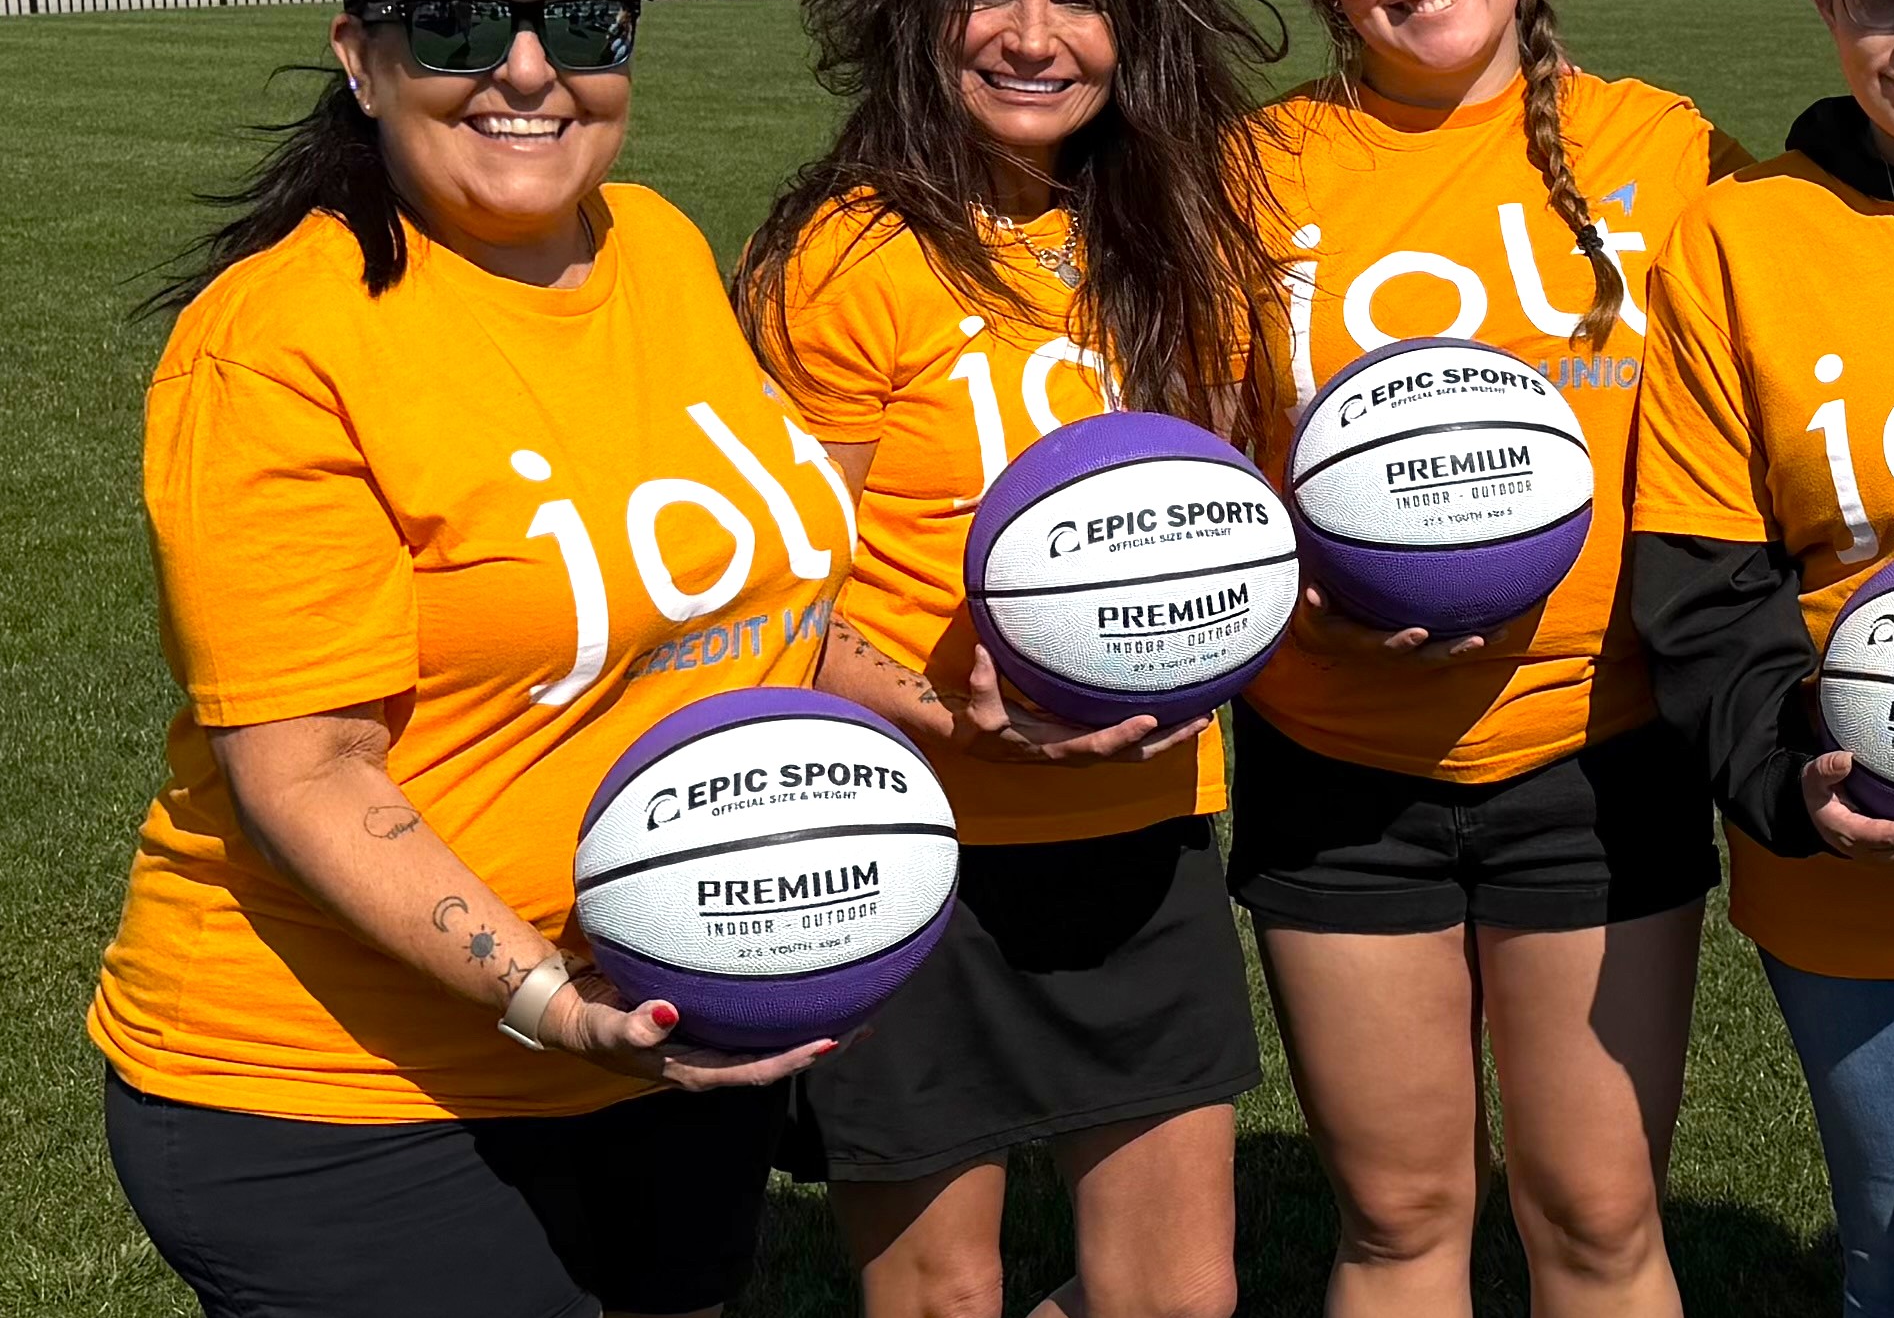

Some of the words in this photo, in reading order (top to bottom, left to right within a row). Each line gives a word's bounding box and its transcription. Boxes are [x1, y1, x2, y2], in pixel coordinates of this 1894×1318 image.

[1283, 202, 1648, 423] jolt
[1371, 372, 1434, 406] EPIC
[1443, 368, 1546, 395] SPORTS
[1539, 355, 1641, 390] UNIO
[1386, 446, 1530, 484] PREMIUM
[1396, 491, 1450, 509] INDOOR
[1472, 480, 1532, 499] OUTDOOR
[1087, 509, 1157, 544] EPIC
[1167, 501, 1269, 527] SPORTS
[1109, 535, 1155, 552] OFFICIAL
[1098, 582, 1249, 628] PREMIUM
[628, 615, 768, 681] REDIT
[1106, 640, 1164, 654] INDOOR
[687, 768, 768, 810] EPIC
[779, 762, 908, 794] SPORTS
[711, 797, 765, 816] OFFICIAL
[769, 793, 796, 803] SIZE
[800, 791, 808, 800] &
[813, 791, 857, 799] WEIGHT
[698, 861, 879, 905] PREMIUM
[707, 920, 774, 936] INDOOR
[802, 902, 877, 929] OUTDOOR
[770, 942, 812, 955] YOUTH
